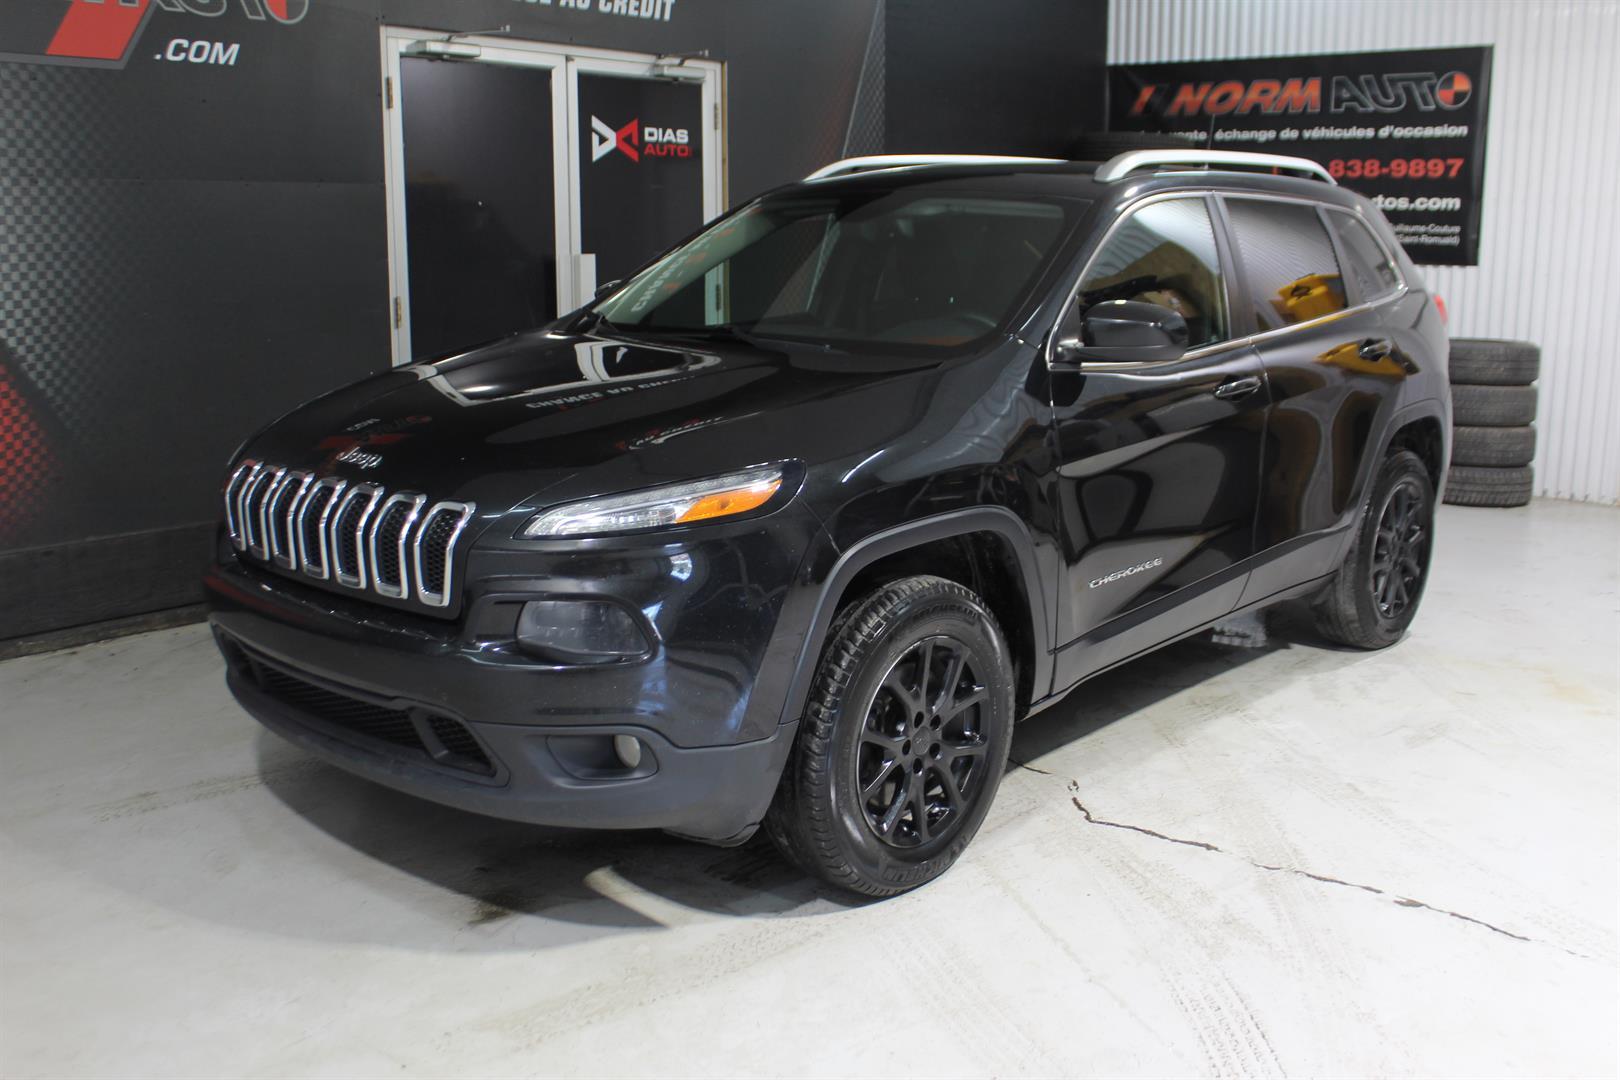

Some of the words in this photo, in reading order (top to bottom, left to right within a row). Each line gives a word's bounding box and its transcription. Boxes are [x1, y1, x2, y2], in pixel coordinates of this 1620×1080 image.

[598, 0, 675, 22] CREDIT
[154, 38, 240, 65] .COM
[1164, 78, 1321, 116] NORM
[644, 127, 689, 144] DIAS
[1278, 127, 1298, 139] de
[1301, 126, 1375, 140] véhicules
[1377, 124, 1468, 138] d'occasion
[644, 142, 691, 157] AUTO
[1328, 158, 1464, 179] 838-9897
[336, 446, 384, 471] Jeep
[1089, 557, 1163, 589] CHEROKEE
